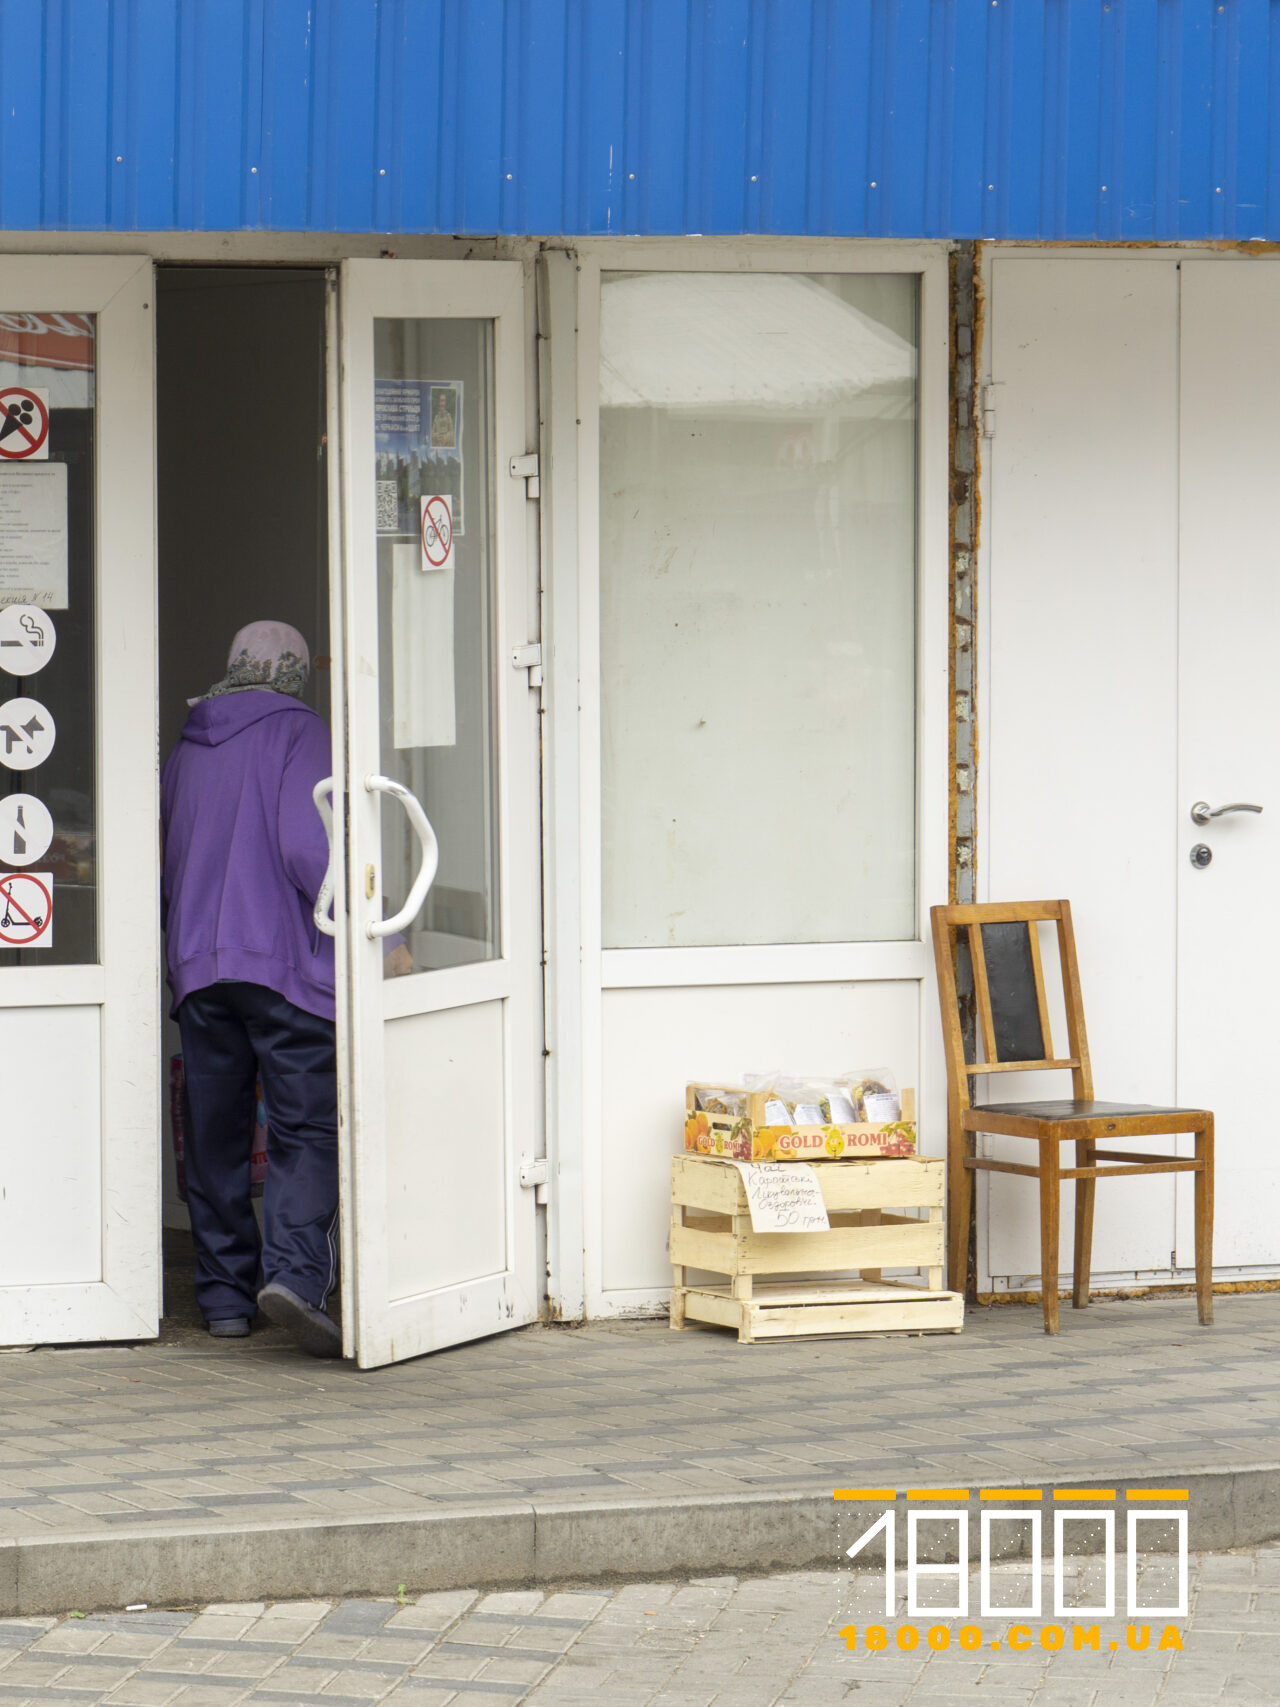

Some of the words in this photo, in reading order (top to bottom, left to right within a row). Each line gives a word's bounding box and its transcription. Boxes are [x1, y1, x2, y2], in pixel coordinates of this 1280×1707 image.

[697, 1134, 716, 1148] GOLD
[723, 1139, 741, 1151] ROMI
[779, 1135, 823, 1149] GOLD
[847, 1133, 887, 1147] ROMI
[774, 1210, 800, 1228] 50
